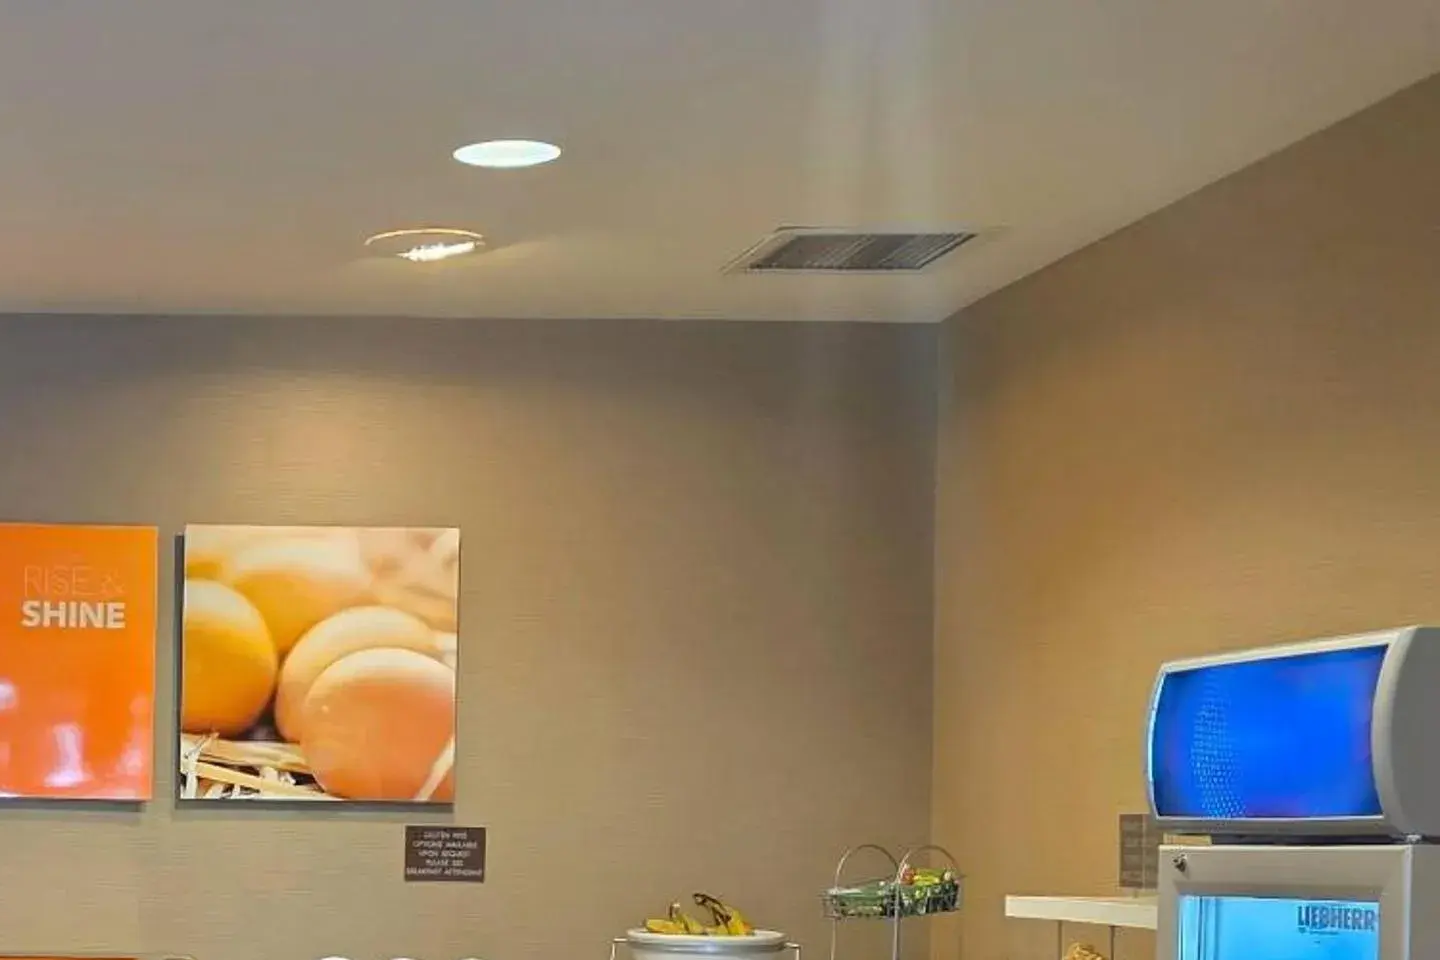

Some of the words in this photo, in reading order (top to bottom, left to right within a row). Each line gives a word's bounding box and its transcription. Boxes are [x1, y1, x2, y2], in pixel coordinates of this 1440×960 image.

[23, 564, 99, 598] RISE
[21, 600, 126, 628] SHINE
[1297, 905, 1376, 932] LIEBHERR
